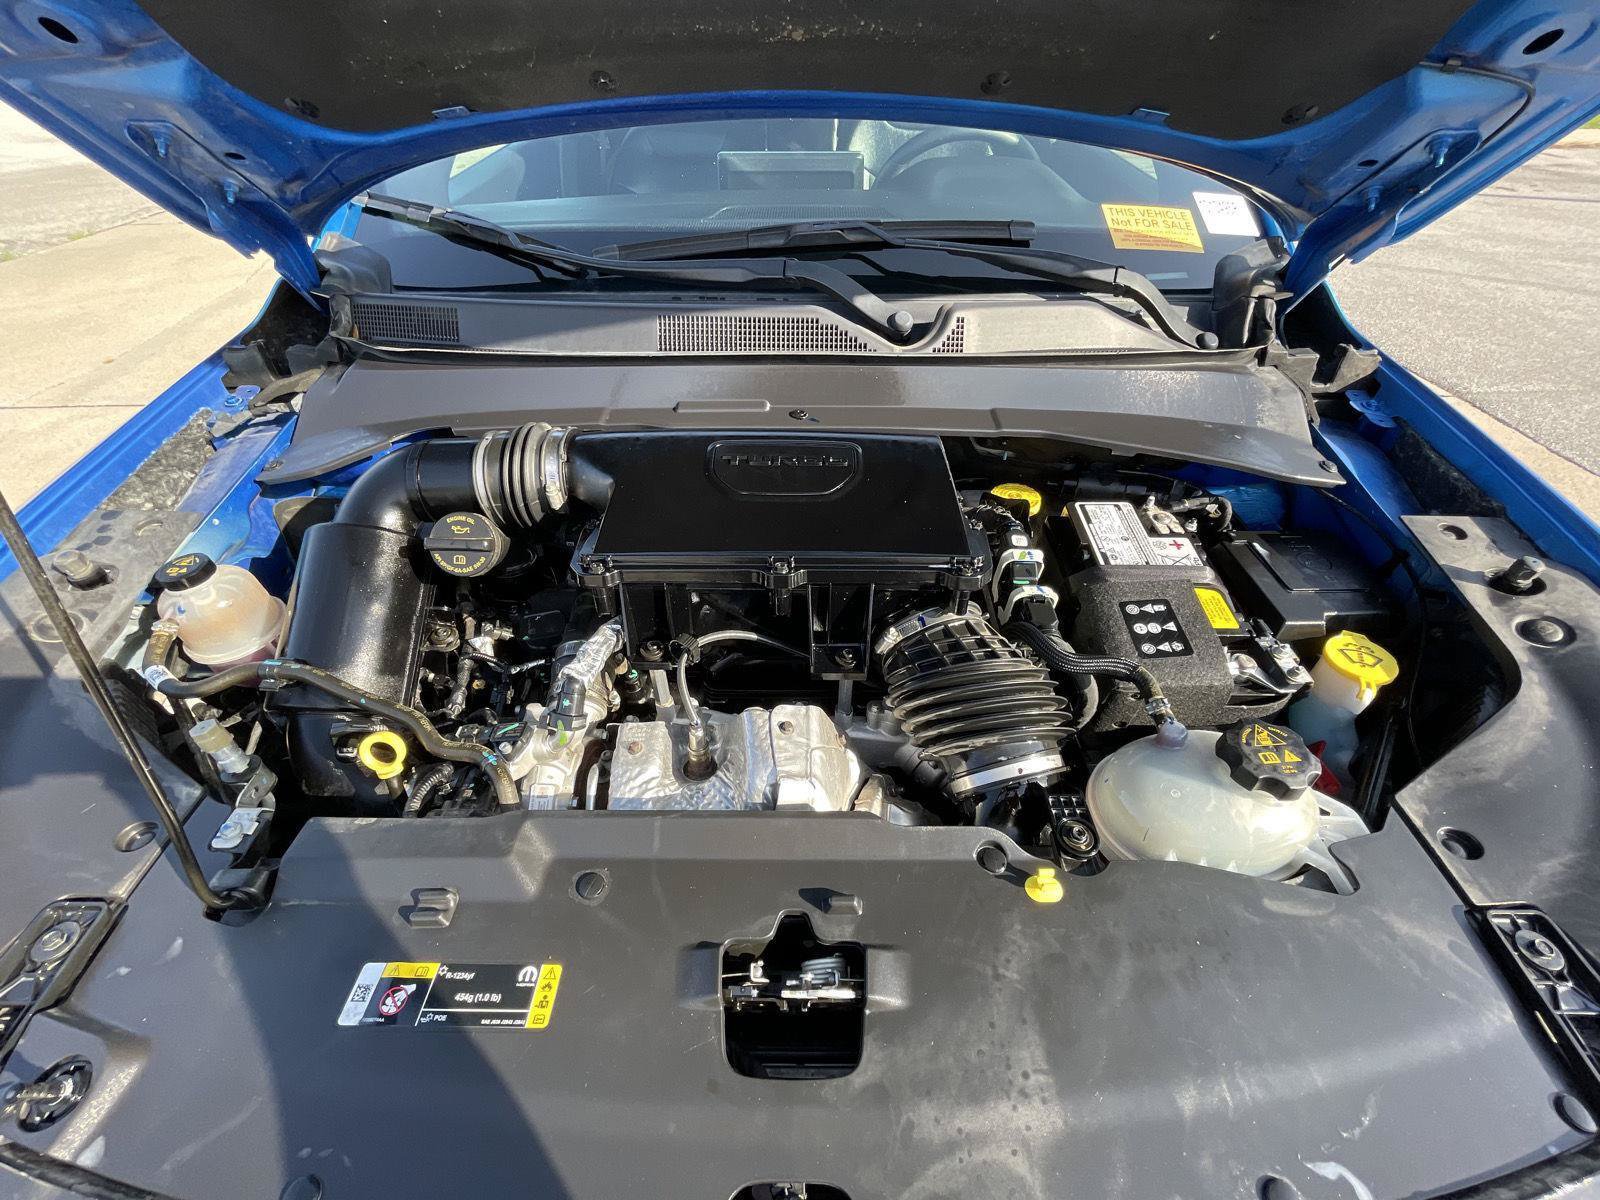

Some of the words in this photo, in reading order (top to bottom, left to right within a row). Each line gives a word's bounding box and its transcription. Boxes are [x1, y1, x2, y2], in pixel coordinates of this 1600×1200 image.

[1109, 207, 1135, 217] THIS
[1137, 209, 1188, 221] VEHICLE
[1134, 219, 1160, 228] FOR
[1162, 220, 1193, 231] SALE
[446, 515, 467, 524] ENGINE
[467, 516, 475, 525] OIL
[446, 972, 475, 981] R-1234yf
[454, 993, 474, 1003] 454g
